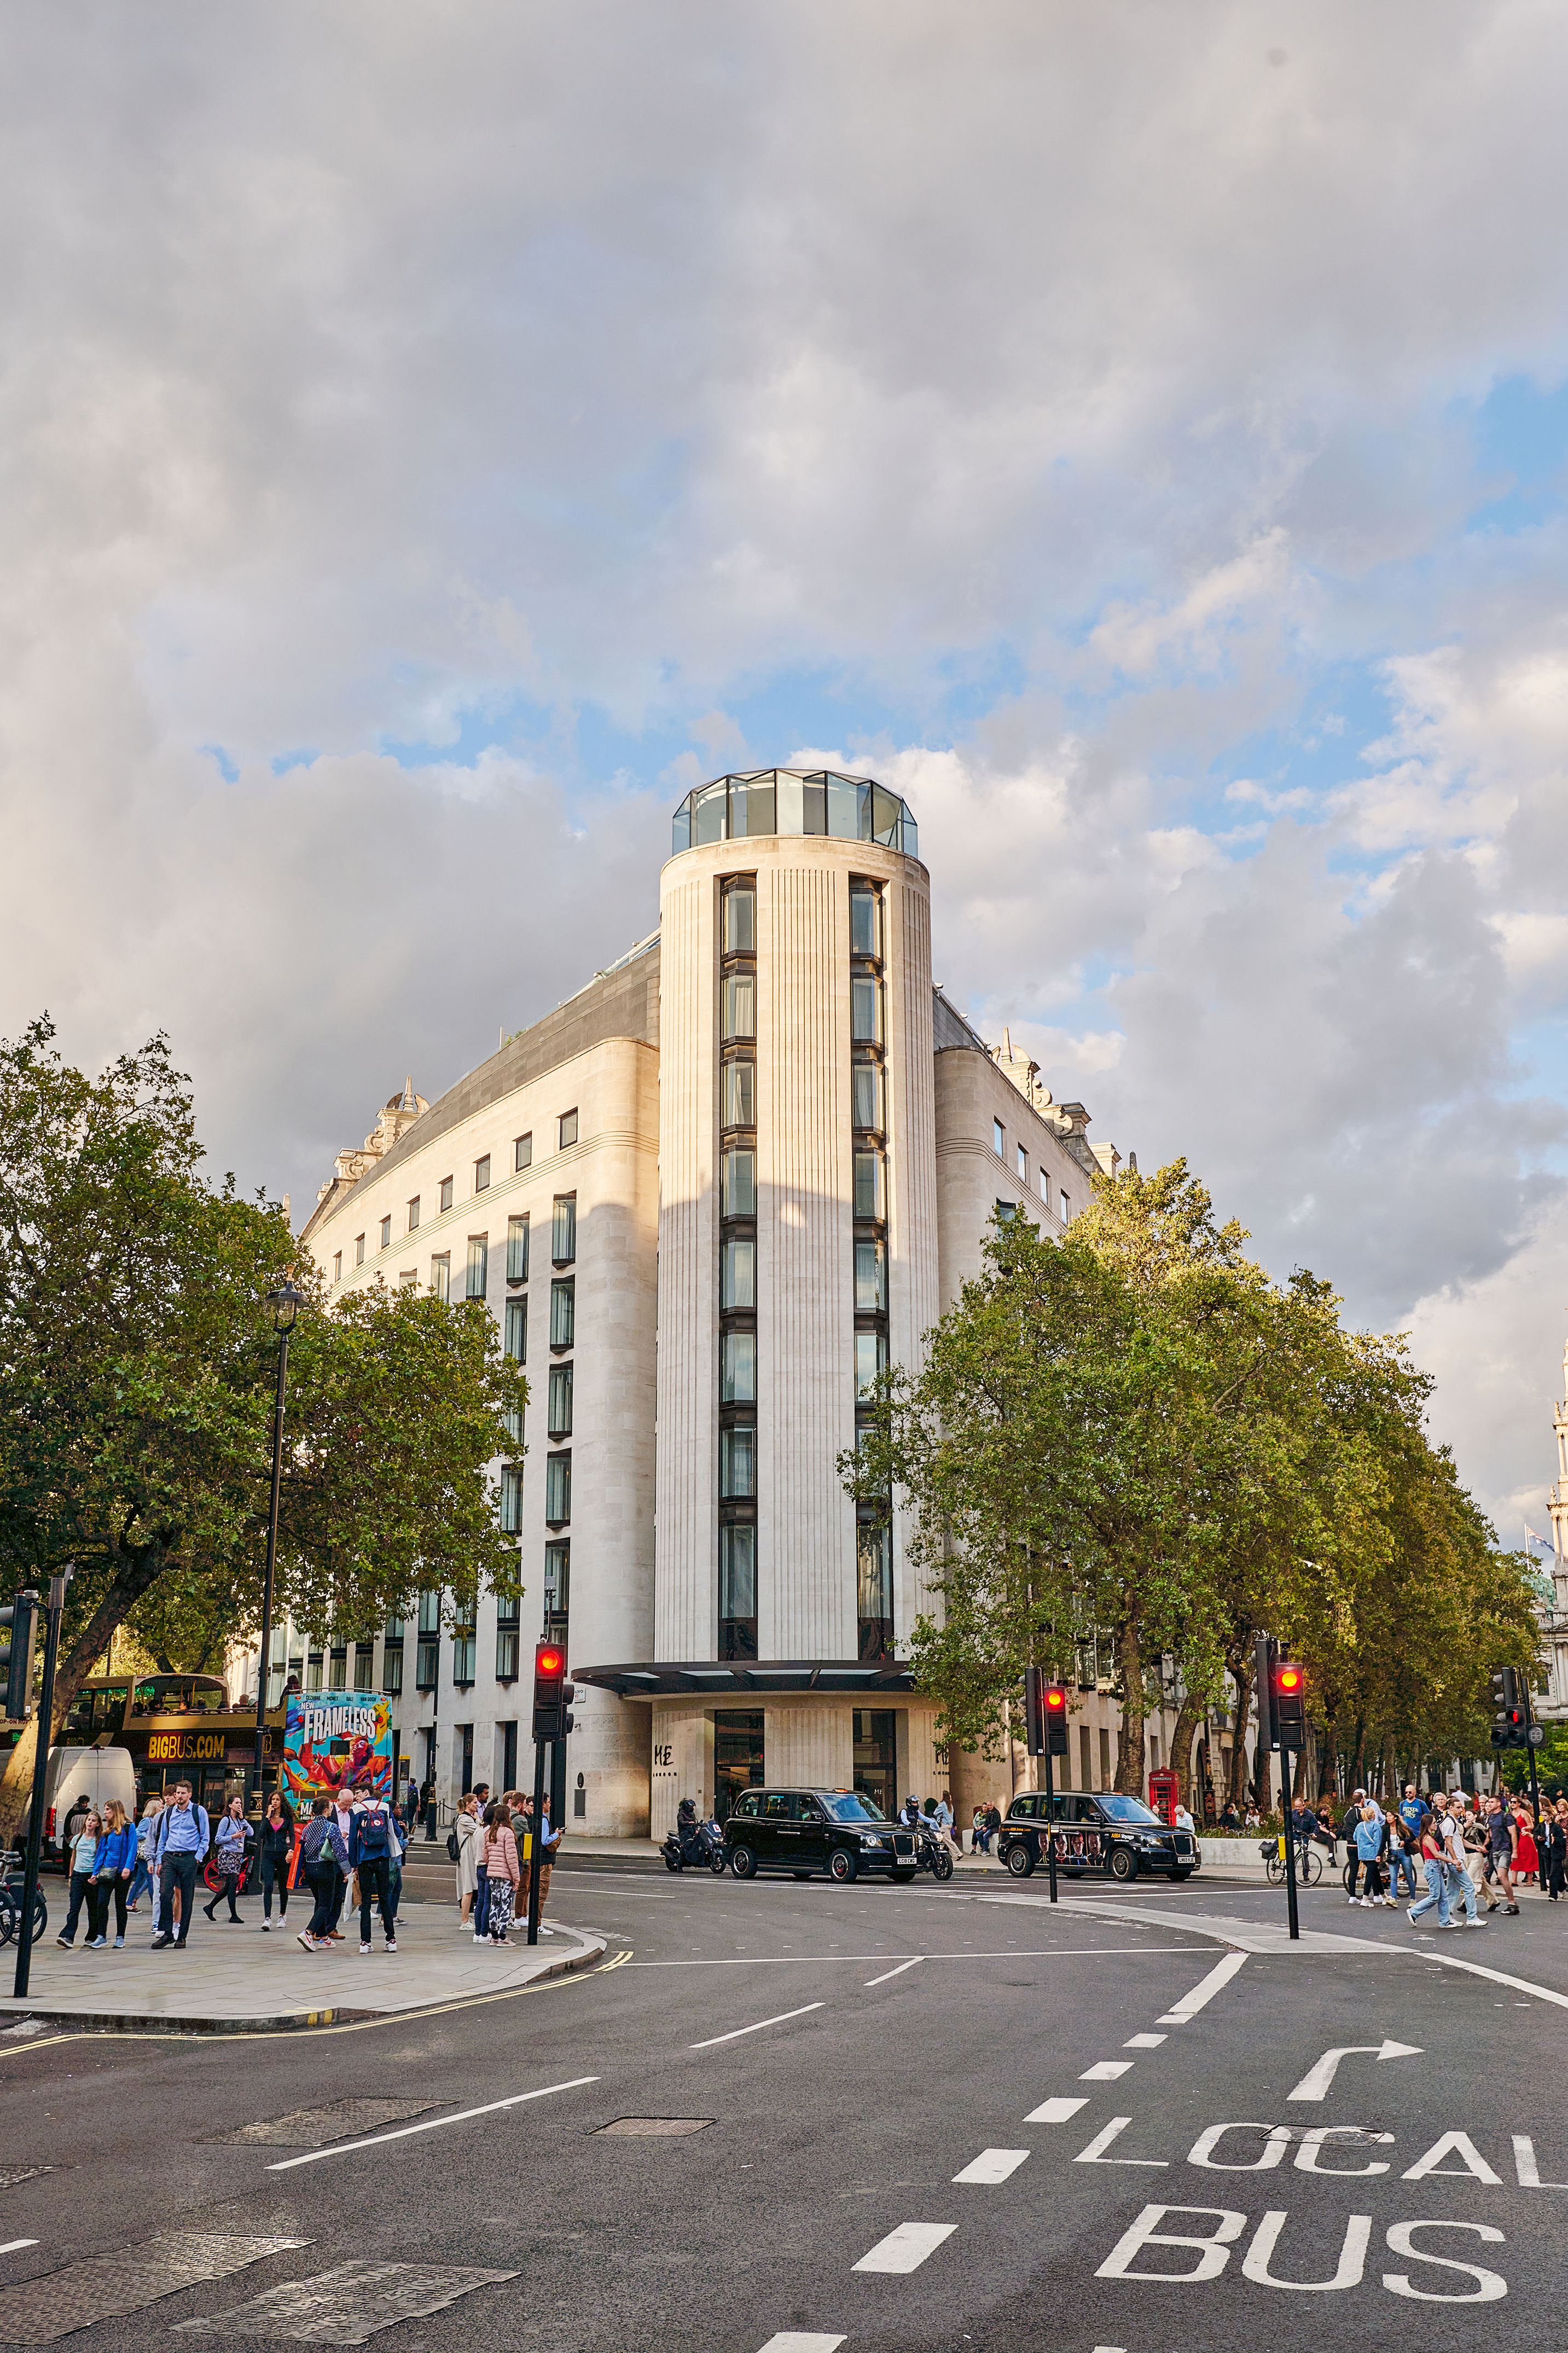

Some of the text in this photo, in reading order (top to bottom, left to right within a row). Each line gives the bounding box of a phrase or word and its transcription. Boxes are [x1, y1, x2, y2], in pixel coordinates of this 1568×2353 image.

[301, 1702, 314, 1710] NEW
[304, 1706, 376, 1744] FRAMELESS
[148, 1735, 225, 1758] BIGBUS.COM
[654, 1745, 674, 1766] ME
[1071, 2117, 1568, 2188] LOCAL
[1094, 2204, 1508, 2303] BUS
